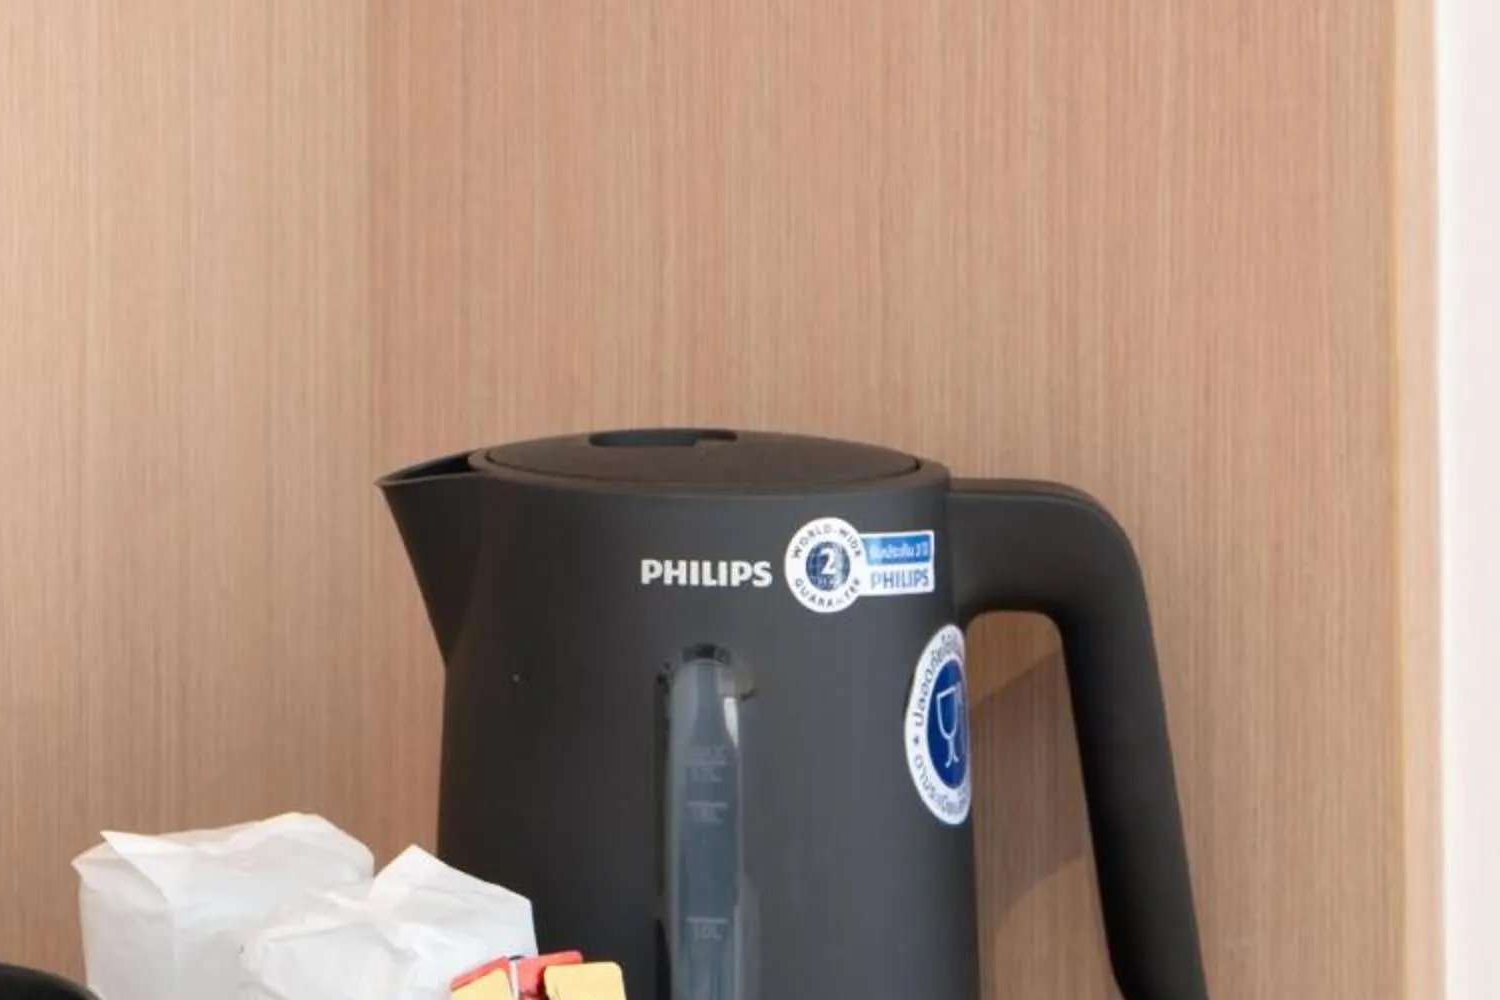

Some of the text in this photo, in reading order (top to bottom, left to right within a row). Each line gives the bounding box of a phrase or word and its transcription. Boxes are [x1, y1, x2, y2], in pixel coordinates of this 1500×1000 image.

[640, 558, 773, 588] PHILIPS
[820, 548, 836, 576] 2
[871, 568, 930, 590] PHILIPS
